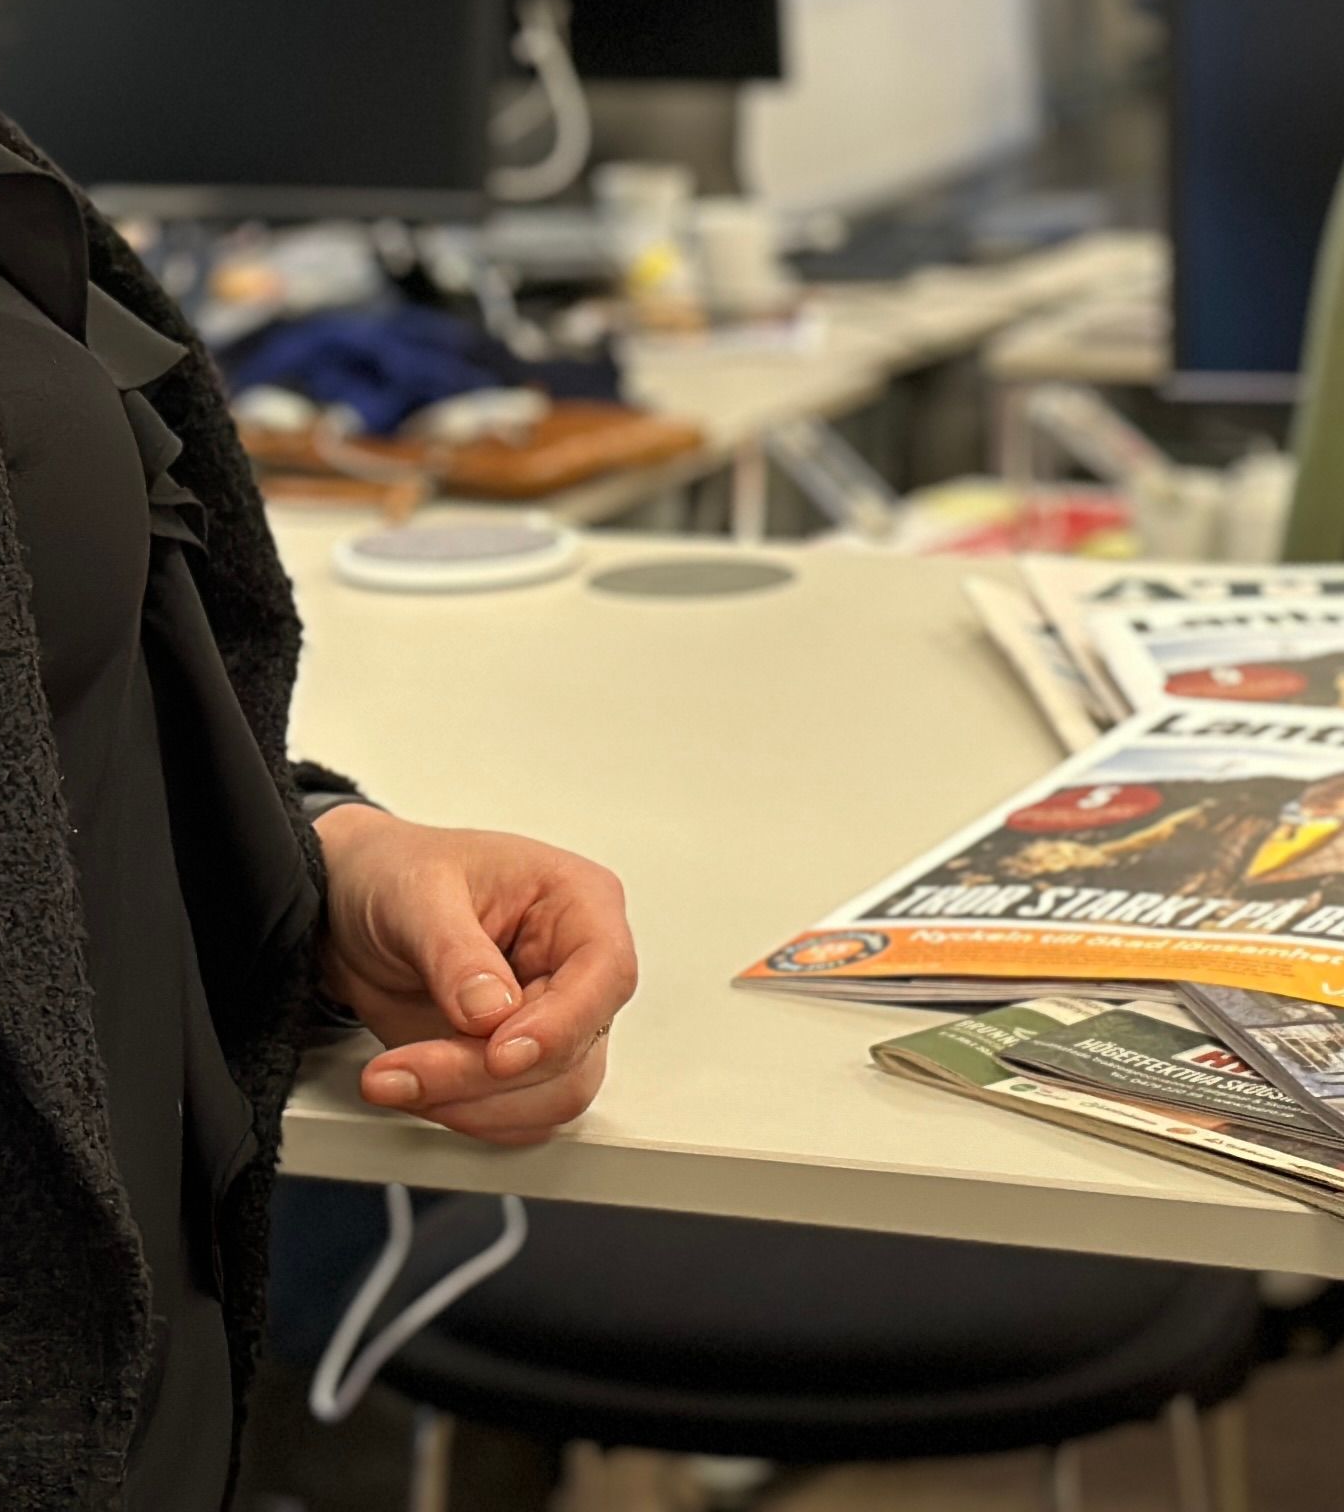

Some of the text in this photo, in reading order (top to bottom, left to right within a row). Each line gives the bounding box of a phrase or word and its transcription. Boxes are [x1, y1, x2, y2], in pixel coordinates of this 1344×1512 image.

[1017, 886, 1233, 928] STARKT
[1217, 897, 1310, 932] PÅ
[1073, 1038, 1224, 1086] HÖGEFFEKTIVA
[1217, 1079, 1296, 1104] SKOGS
